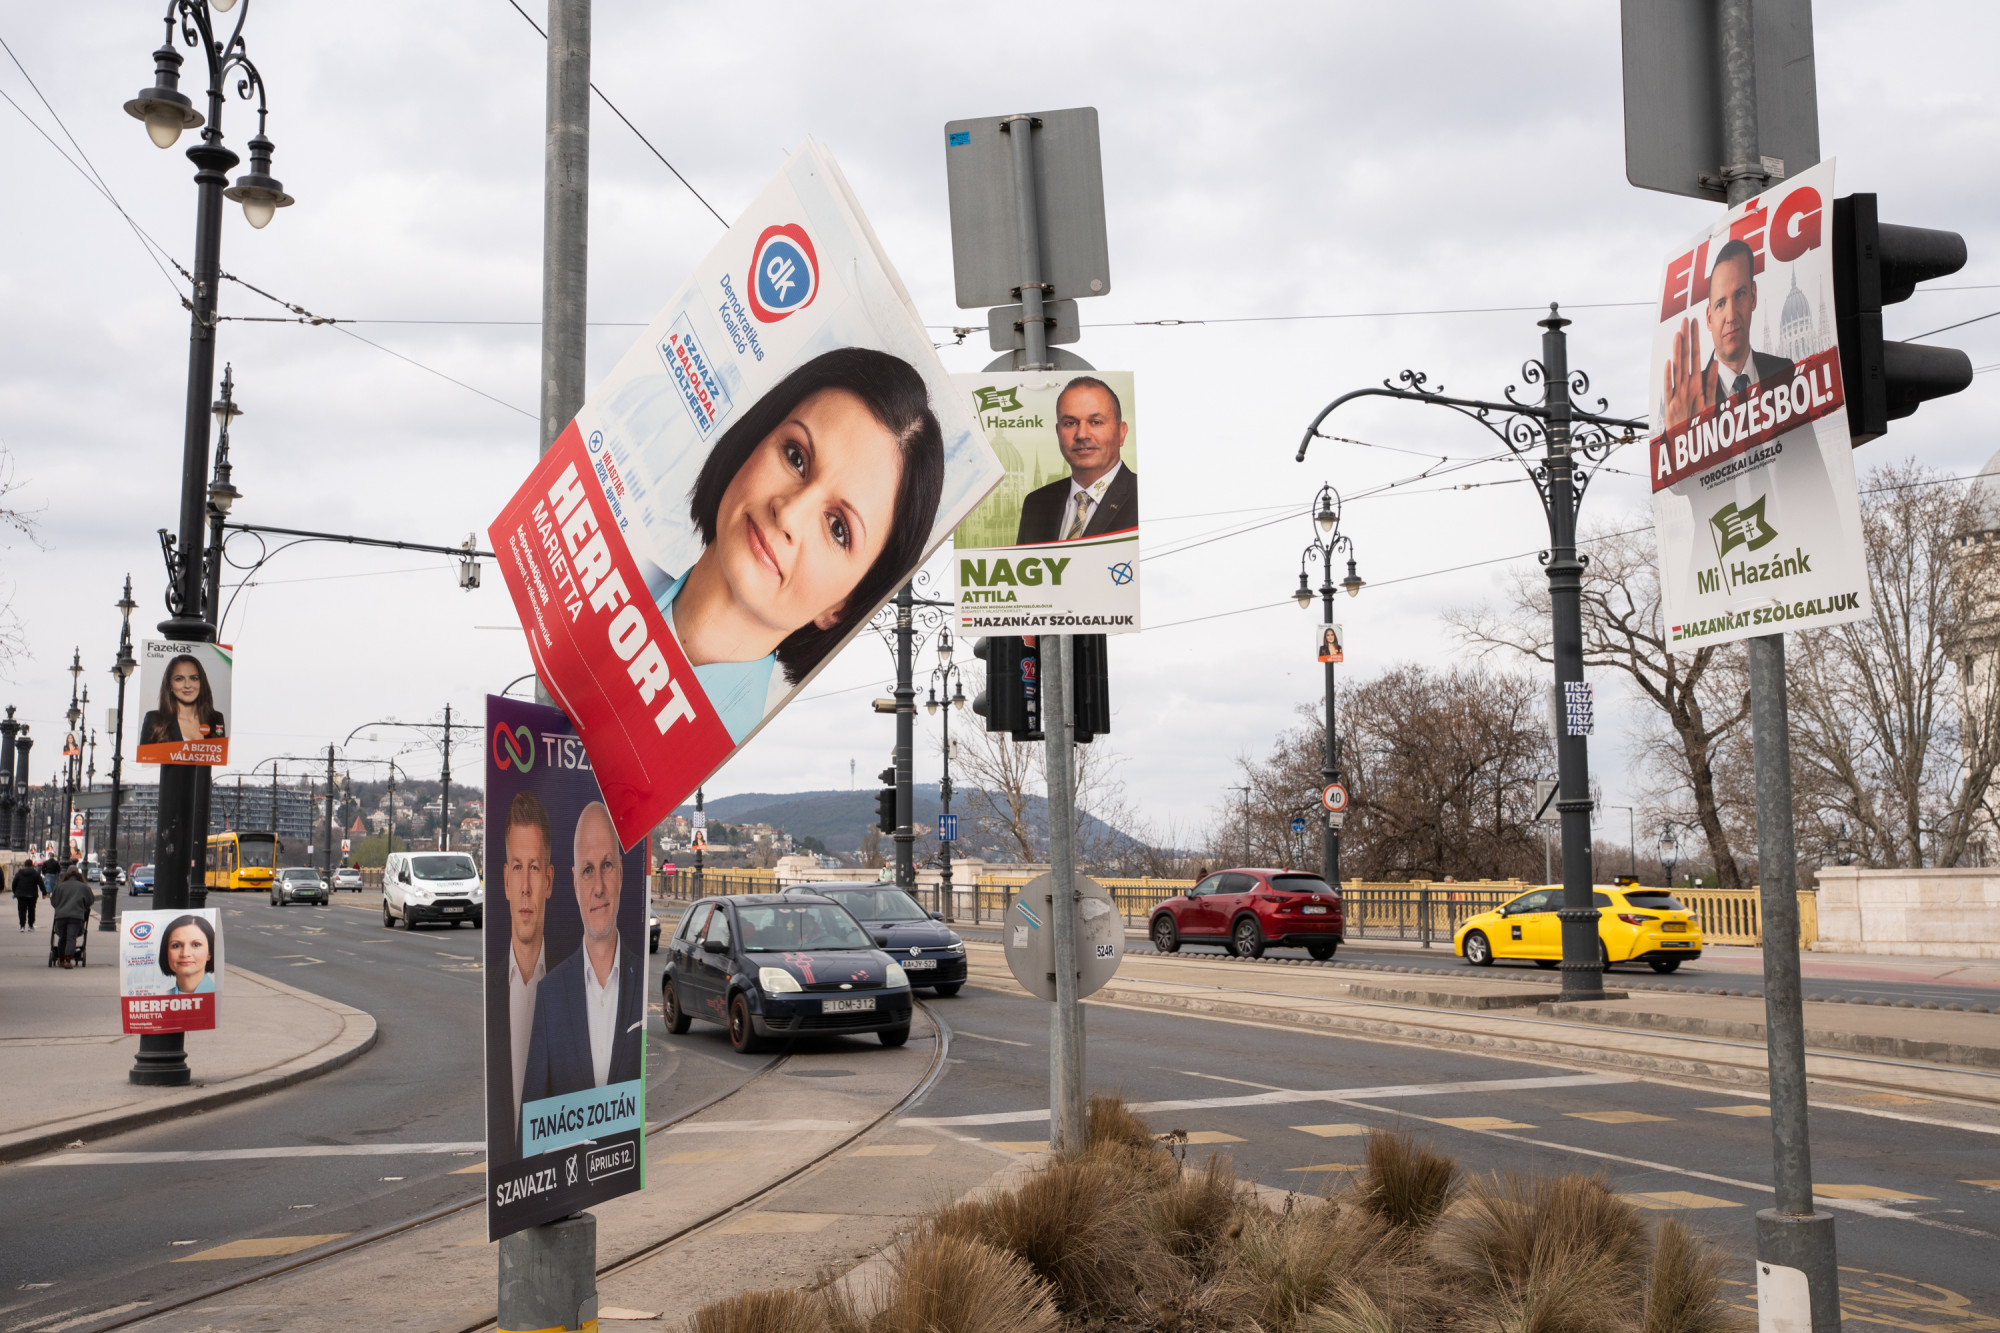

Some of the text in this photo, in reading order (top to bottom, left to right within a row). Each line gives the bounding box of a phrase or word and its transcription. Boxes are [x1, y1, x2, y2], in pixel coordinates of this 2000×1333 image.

[1660, 186, 1822, 324] ELÉG
[766, 255, 796, 303] dk
[718, 302, 746, 355] Koalíció
[719, 273, 765, 362] Demokratikus
[662, 342, 711, 433] JELÖLTJÉRE!
[669, 333, 717, 422] A BALOLDAL
[683, 333, 720, 400] SZAVAZZ
[987, 414, 1044, 428] Hazánk
[1657, 362, 1834, 480] A BŰNÖZÉSBŐL!
[602, 450, 626, 500] VÁLASZTÁS:
[1700, 440, 1783, 487] TOROCZKAI LÁSZLÓ
[594, 460, 630, 533] 2026. április 12.
[508, 535, 527, 579] Budapest
[516, 524, 550, 606] képviselőjelölt
[531, 498, 584, 624] MARIETTA
[960, 557, 1072, 587] NAGY
[1697, 547, 1812, 595] Mi Hazánk
[548, 460, 697, 736] HERFORT
[961, 590, 1018, 603] ATTILA
[1682, 592, 1860, 640] HAZÁNKAT SZOLGÁLJUK
[974, 615, 1134, 627] HAZÁNKAT SZOLGÁLJUK
[147, 642, 192, 653] Fazekas
[1564, 682, 1592, 692] TISZA
[1565, 692, 1593, 702] TISZA
[1566, 704, 1593, 714] TISZA
[1567, 714, 1594, 725] TISZA
[1567, 726, 1594, 736] TISZA
[169, 751, 222, 762] VÁLASZTÁS
[191, 744, 222, 752] BIZTOS
[542, 737, 592, 770] TISZ
[1330, 792, 1341, 803] 40
[137, 926, 148, 934] dk
[1097, 945, 1113, 957] 524R
[129, 997, 203, 1013] HERFORT
[832, 1000, 874, 1010] IOM-312
[530, 1092, 635, 1141] TANÁCS ZOLTÁN
[496, 1149, 632, 1207] SZAVAZZ! ÁPRILIS 12.
